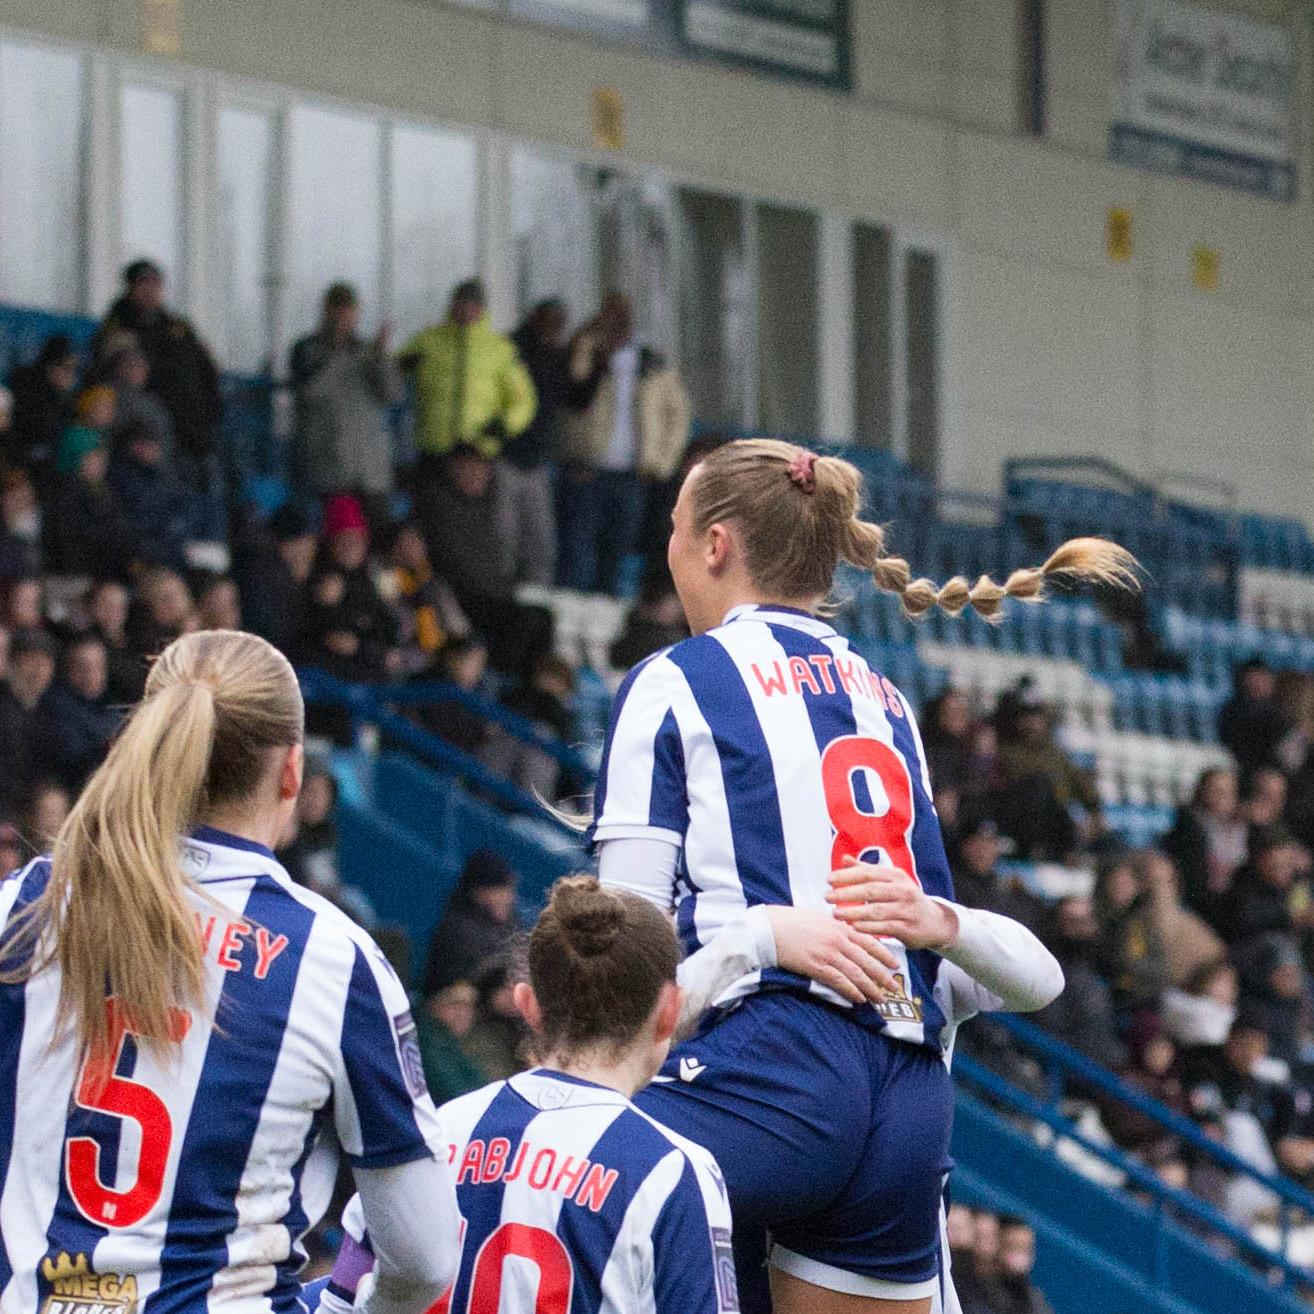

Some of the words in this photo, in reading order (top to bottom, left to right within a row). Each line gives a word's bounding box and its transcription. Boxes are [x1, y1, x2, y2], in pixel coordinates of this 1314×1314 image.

[750, 654, 904, 718] WATKINS
[820, 734, 923, 940] 8
[65, 997, 193, 1229] 5
[52, 1271, 138, 1304] MEGA
